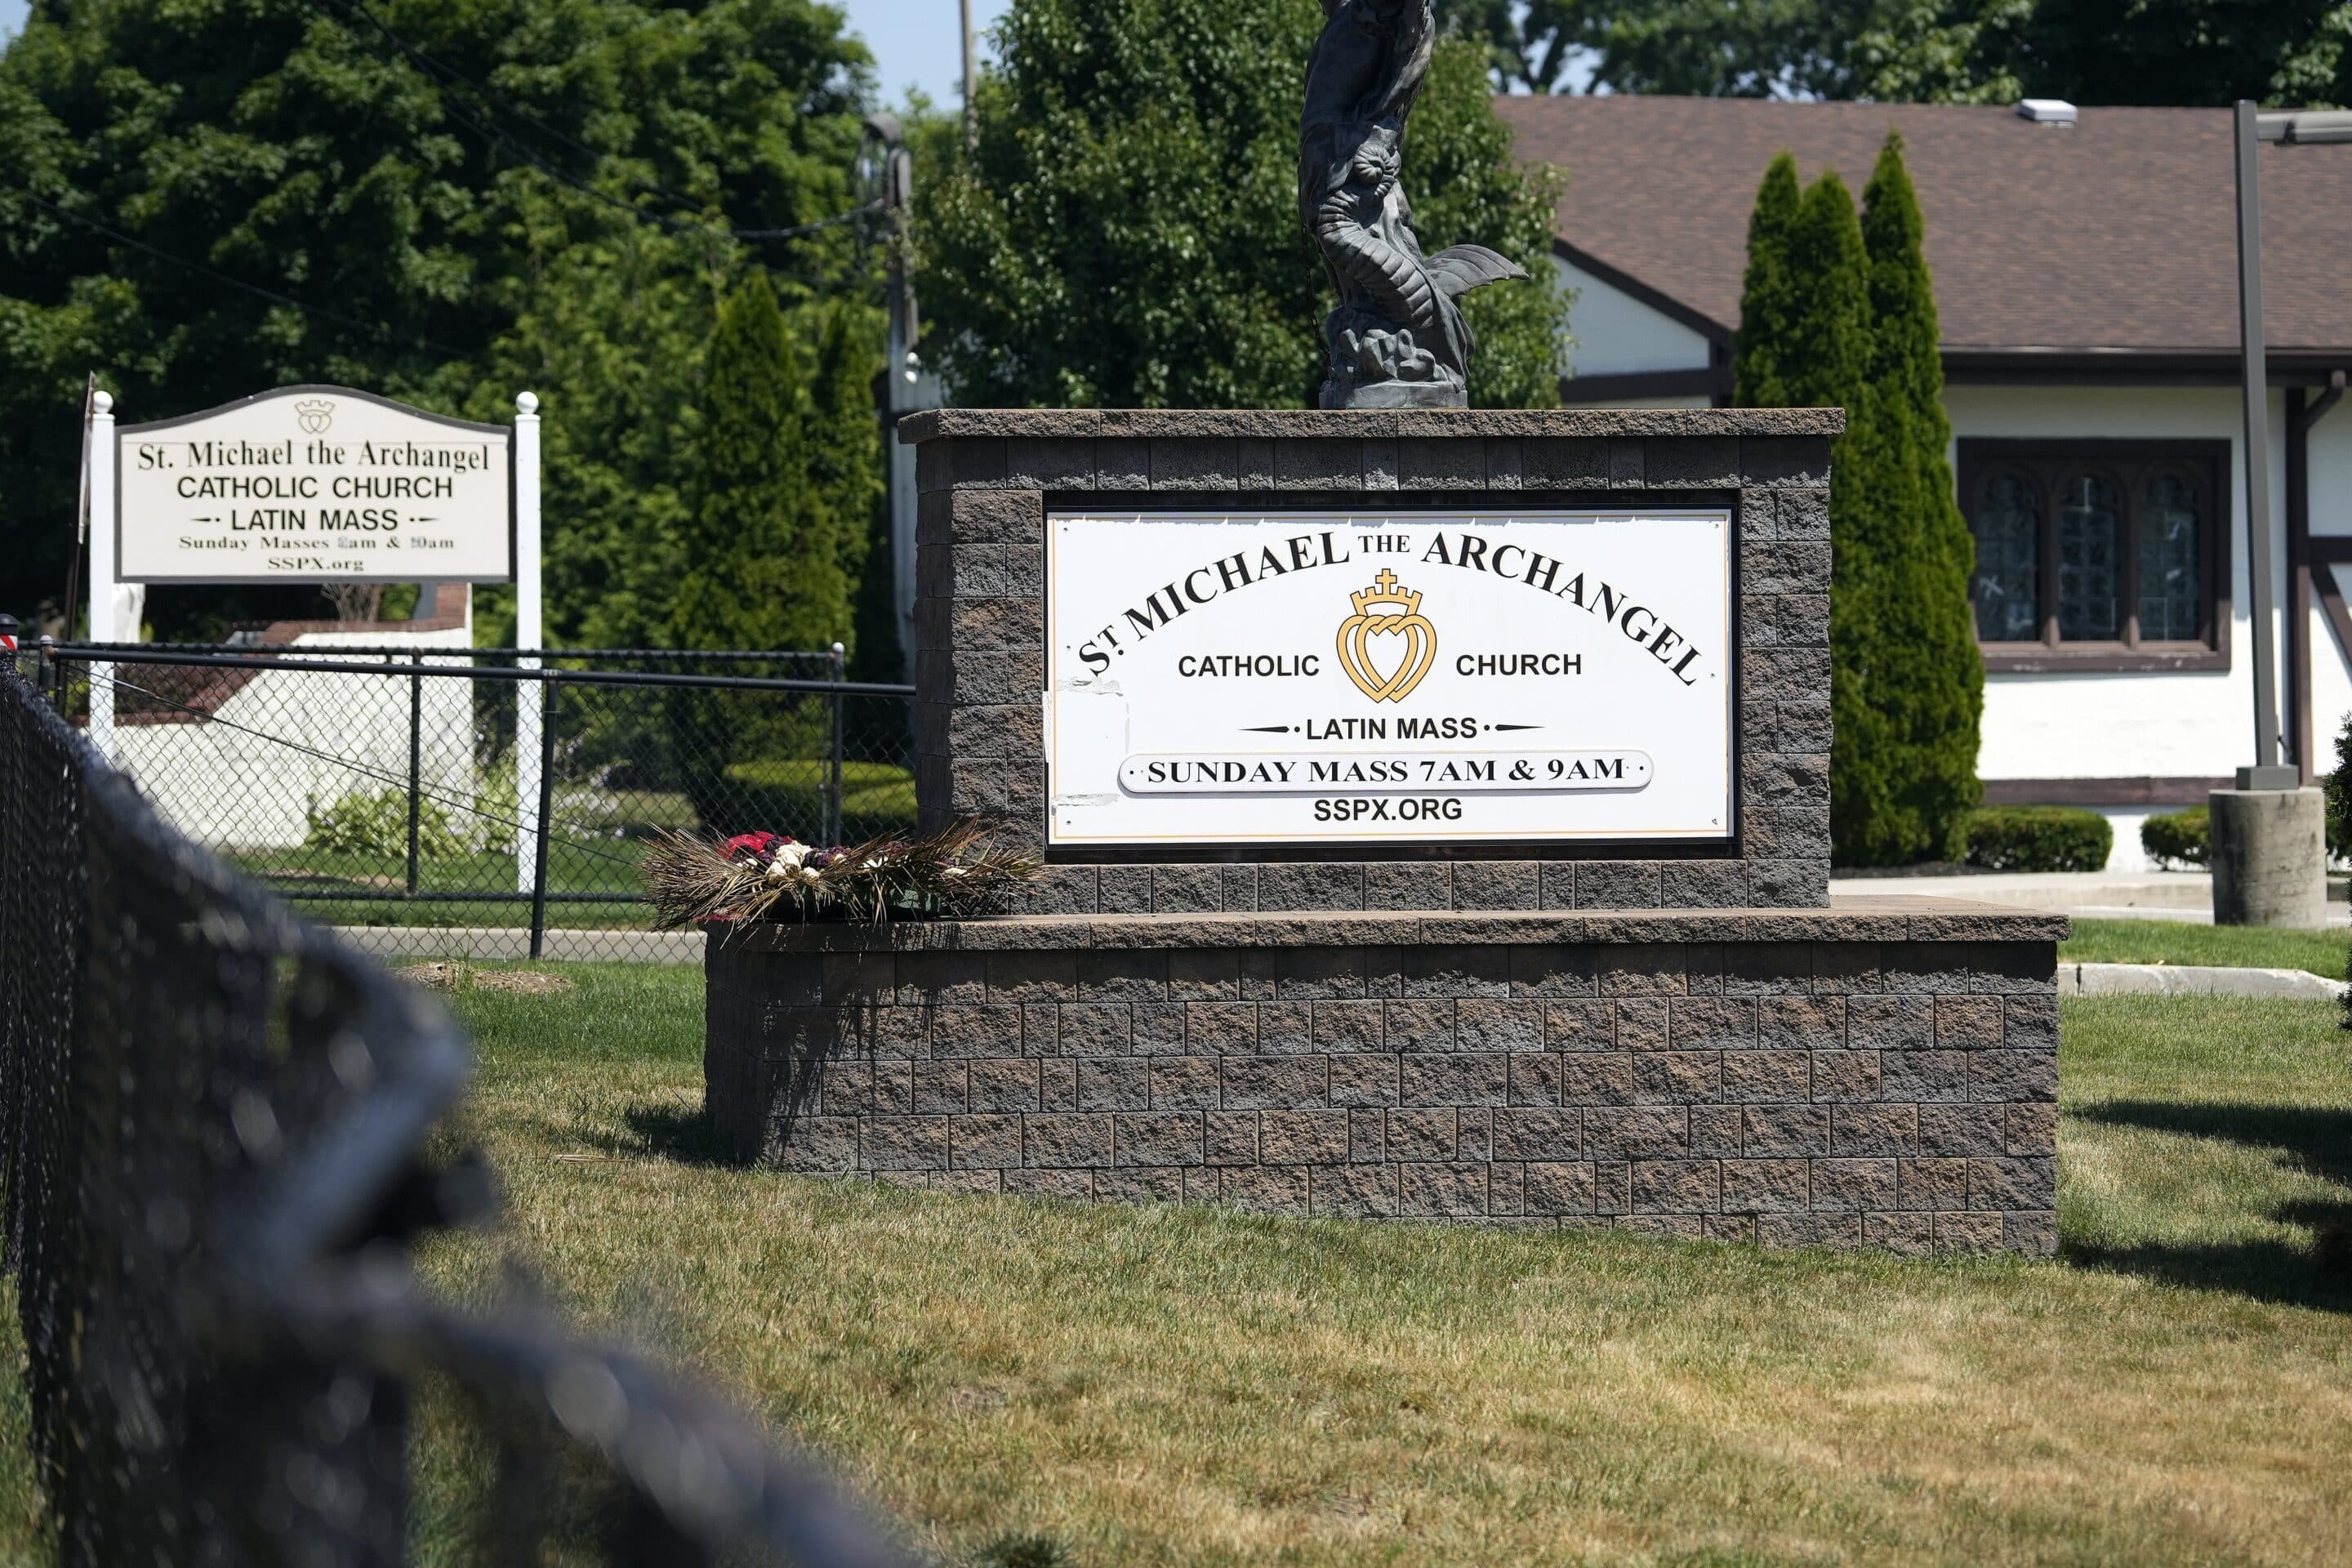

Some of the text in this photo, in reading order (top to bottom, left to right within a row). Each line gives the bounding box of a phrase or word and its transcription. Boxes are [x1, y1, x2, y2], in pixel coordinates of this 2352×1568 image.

[138, 439, 490, 474] St. Michael the Archangel
[176, 476, 453, 499] CATHOLIC CHURCH
[231, 508, 399, 531] LATIN MASS
[179, 536, 249, 551] Sunday
[260, 536, 330, 549] Masses
[385, 536, 400, 549] &
[268, 556, 364, 572] SSPX.org
[1078, 531, 1702, 687] ST. MICHAEL THE ARCHANGEL
[1178, 653, 1582, 678] CATHOLIC CHURCH
[1307, 717, 1478, 741] LATIN MASS
[1147, 758, 1626, 784] SUNDAY MASS 7AM & 9AM
[1313, 798, 1463, 822] SSPX.ORG
